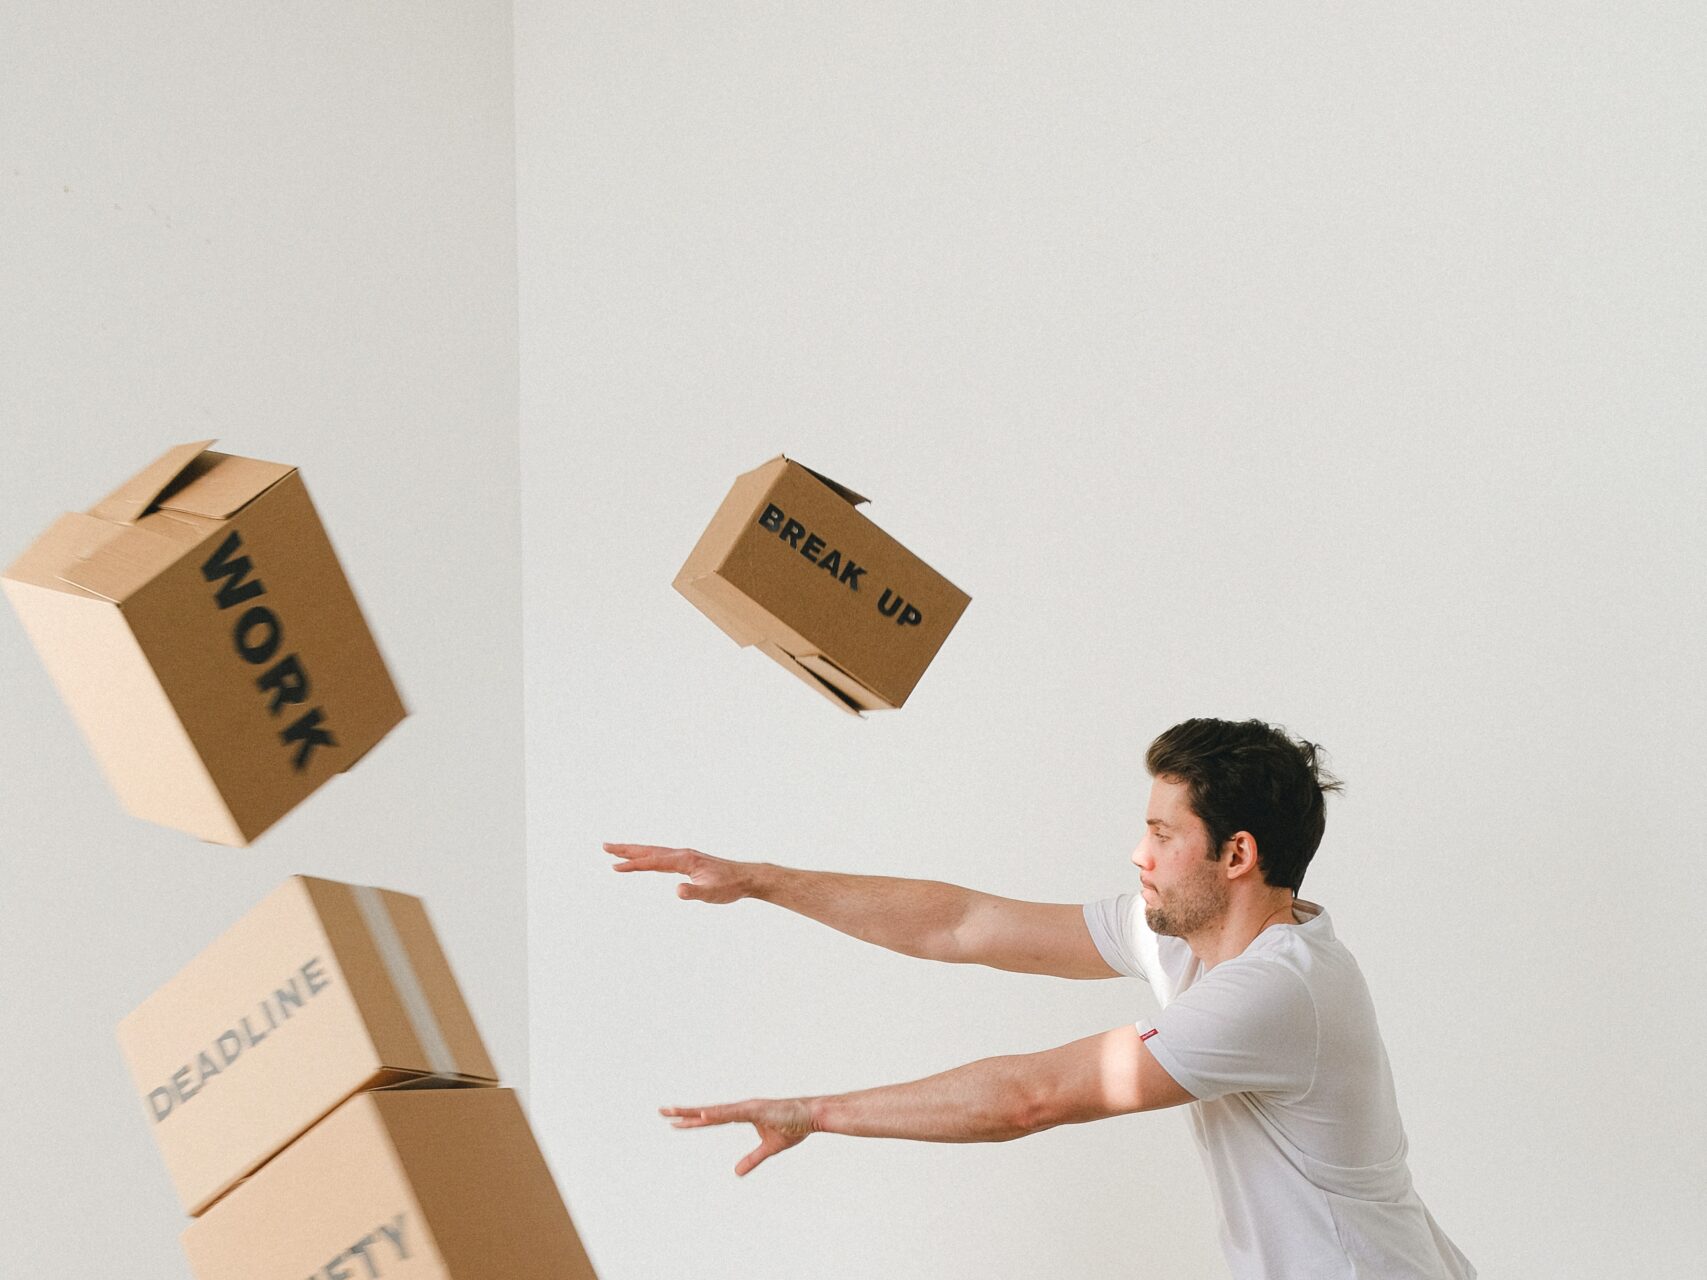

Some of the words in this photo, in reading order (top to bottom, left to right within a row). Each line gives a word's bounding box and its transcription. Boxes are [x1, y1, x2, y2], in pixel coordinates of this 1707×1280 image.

[758, 503, 867, 591] BREAK
[877, 588, 923, 628] UP
[200, 530, 338, 773] WORK
[147, 956, 331, 1123] DEADLINE
